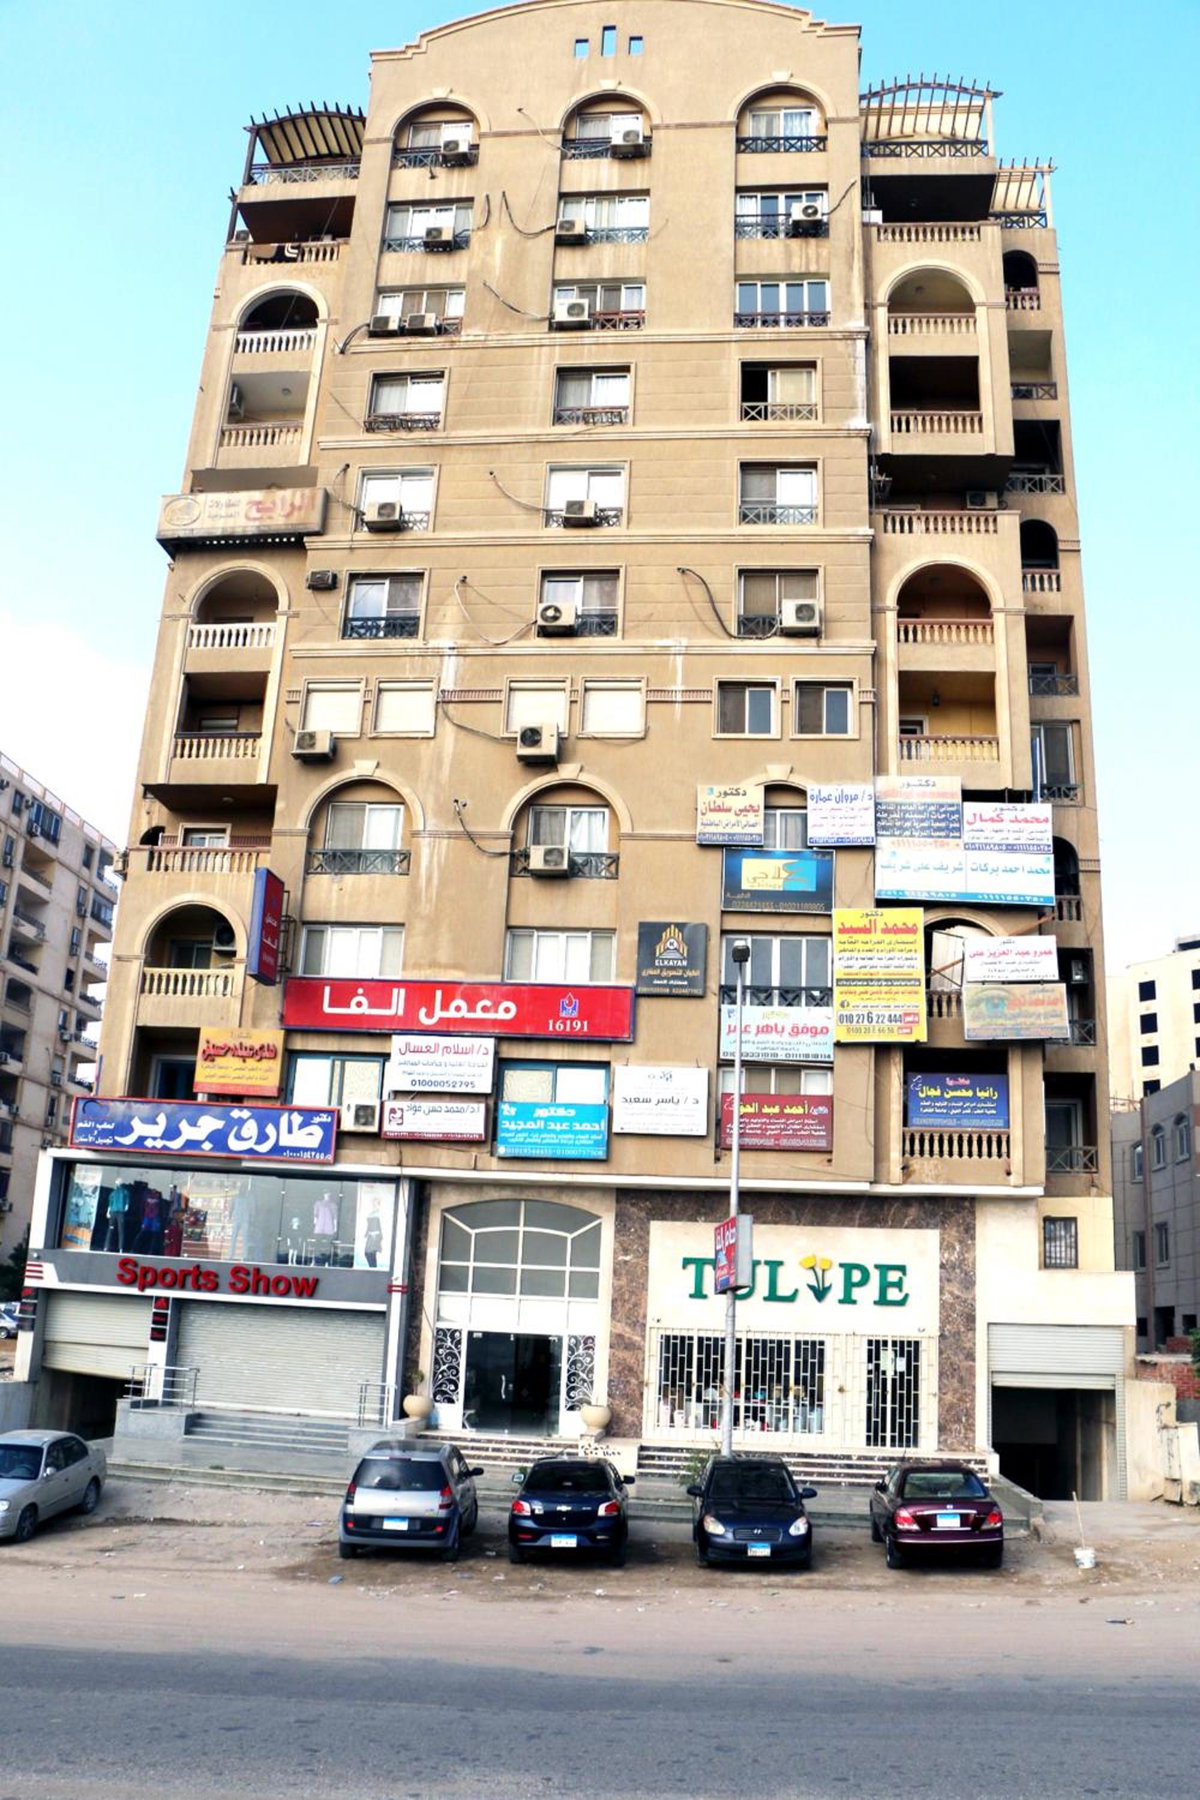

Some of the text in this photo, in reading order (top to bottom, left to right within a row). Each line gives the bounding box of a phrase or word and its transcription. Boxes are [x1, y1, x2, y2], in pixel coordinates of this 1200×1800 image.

[717, 787, 747, 798] دكتور
[810, 788, 832, 804] عمارة
[834, 788, 859, 803] مروان
[700, 800, 732, 816] سلطان
[966, 812, 1049, 825] محمد كمال
[1027, 866, 1050, 874] محمد
[838, 919, 919, 937] محمد السيد
[655, 959, 688, 967] ELKAYAN
[322, 986, 517, 1025] معمل الفا
[839, 1013, 854, 1024] 010
[855, 1013, 865, 1024] 27
[866, 1011, 873, 1023] 6
[875, 1013, 886, 1023] 22
[548, 1018, 589, 1032] 16191
[755, 1022, 785, 1037] باهر
[788, 1023, 829, 1037] موفق
[399, 1042, 440, 1056] العسال
[441, 1044, 475, 1056] اسلام
[411, 1079, 476, 1088] 01000052795
[944, 1088, 973, 1098] محسن
[976, 1087, 998, 1099] رانيا
[621, 1096, 652, 1105] سعيد
[655, 1096, 680, 1106] ياسر
[533, 1106, 576, 1118] دكتور
[762, 1104, 780, 1115] عبد
[783, 1100, 808, 1115] أحمد
[310, 1114, 332, 1124] دكتور
[501, 1120, 545, 1130] المجيد
[114, 1108, 324, 1154] طارق جرير
[547, 1121, 571, 1131] عبد
[117, 1257, 320, 1297] Sports Show
